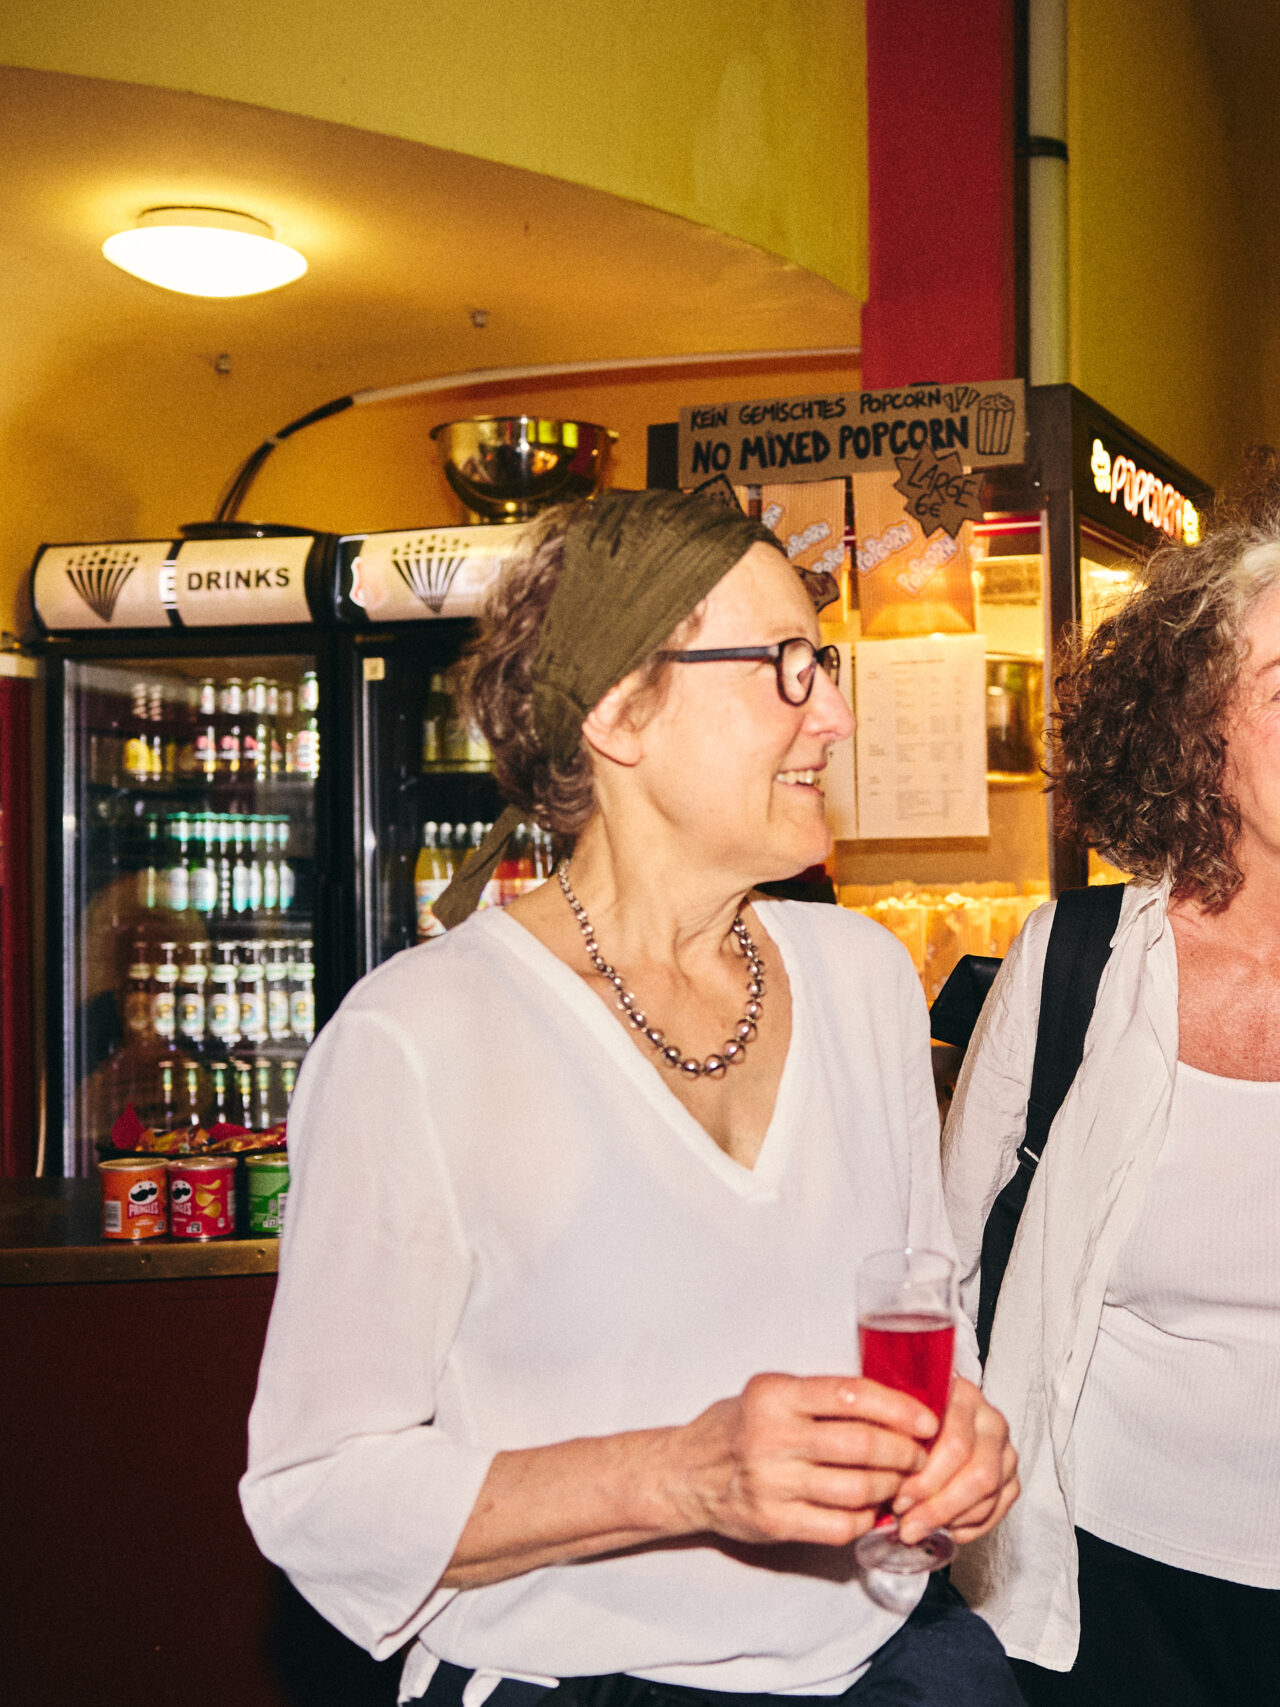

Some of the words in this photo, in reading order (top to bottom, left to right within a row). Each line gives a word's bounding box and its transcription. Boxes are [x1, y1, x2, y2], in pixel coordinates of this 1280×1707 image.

[691, 407, 729, 431] KEIN
[739, 398, 847, 425] GEMISCHTES
[692, 440, 731, 474] NO
[739, 430, 831, 470] MIXED
[839, 416, 969, 459] POPCORN
[907, 460, 977, 508] LARGE
[914, 493, 942, 518] 6€
[188, 568, 290, 591] DRINKS
